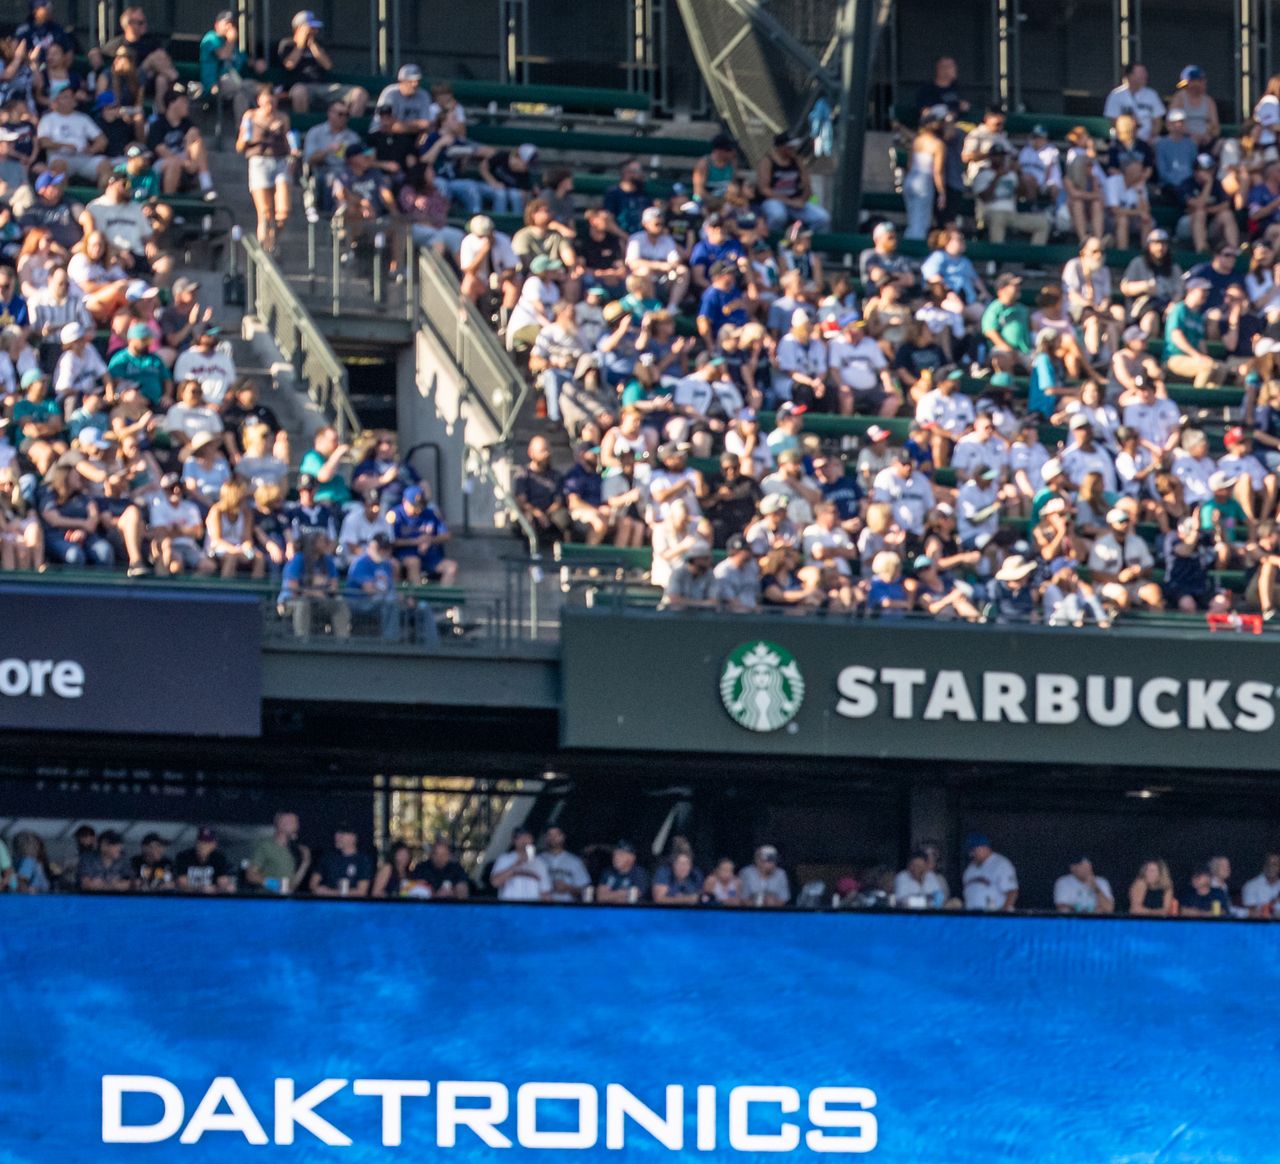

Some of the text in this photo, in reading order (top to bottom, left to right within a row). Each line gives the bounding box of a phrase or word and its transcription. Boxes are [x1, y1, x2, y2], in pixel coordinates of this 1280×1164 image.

[0, 657, 85, 698] ore
[835, 666, 1277, 732] STARBUCKS
[101, 1074, 878, 1153] DAKTRONICS
